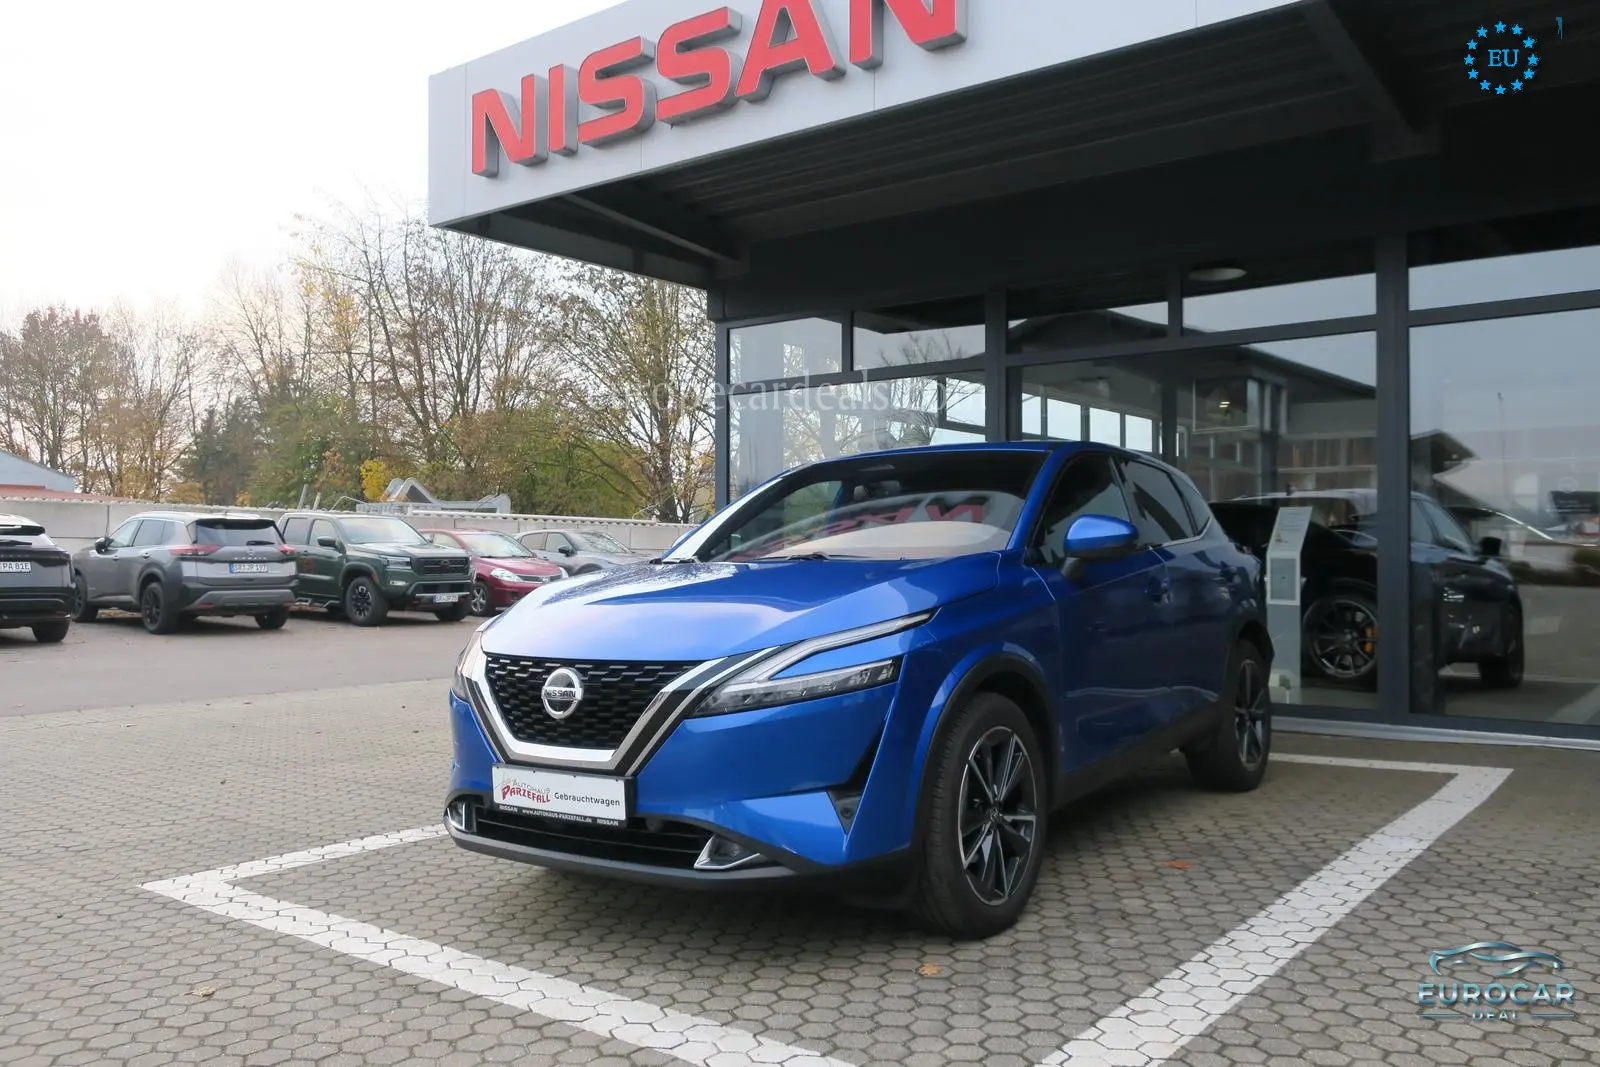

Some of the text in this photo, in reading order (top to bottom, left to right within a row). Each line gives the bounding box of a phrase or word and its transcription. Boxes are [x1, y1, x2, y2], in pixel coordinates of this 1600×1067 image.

[472, 0, 966, 177] NISSAN
[543, 689, 577, 698] NISSAN
[501, 784, 552, 803] PARZEFALL
[512, 779, 551, 794] AUTOHAUS
[554, 792, 621, 807] Gebrauchtwagen
[499, 804, 518, 812] NISSAN
[596, 818, 619, 826] NISSAN
